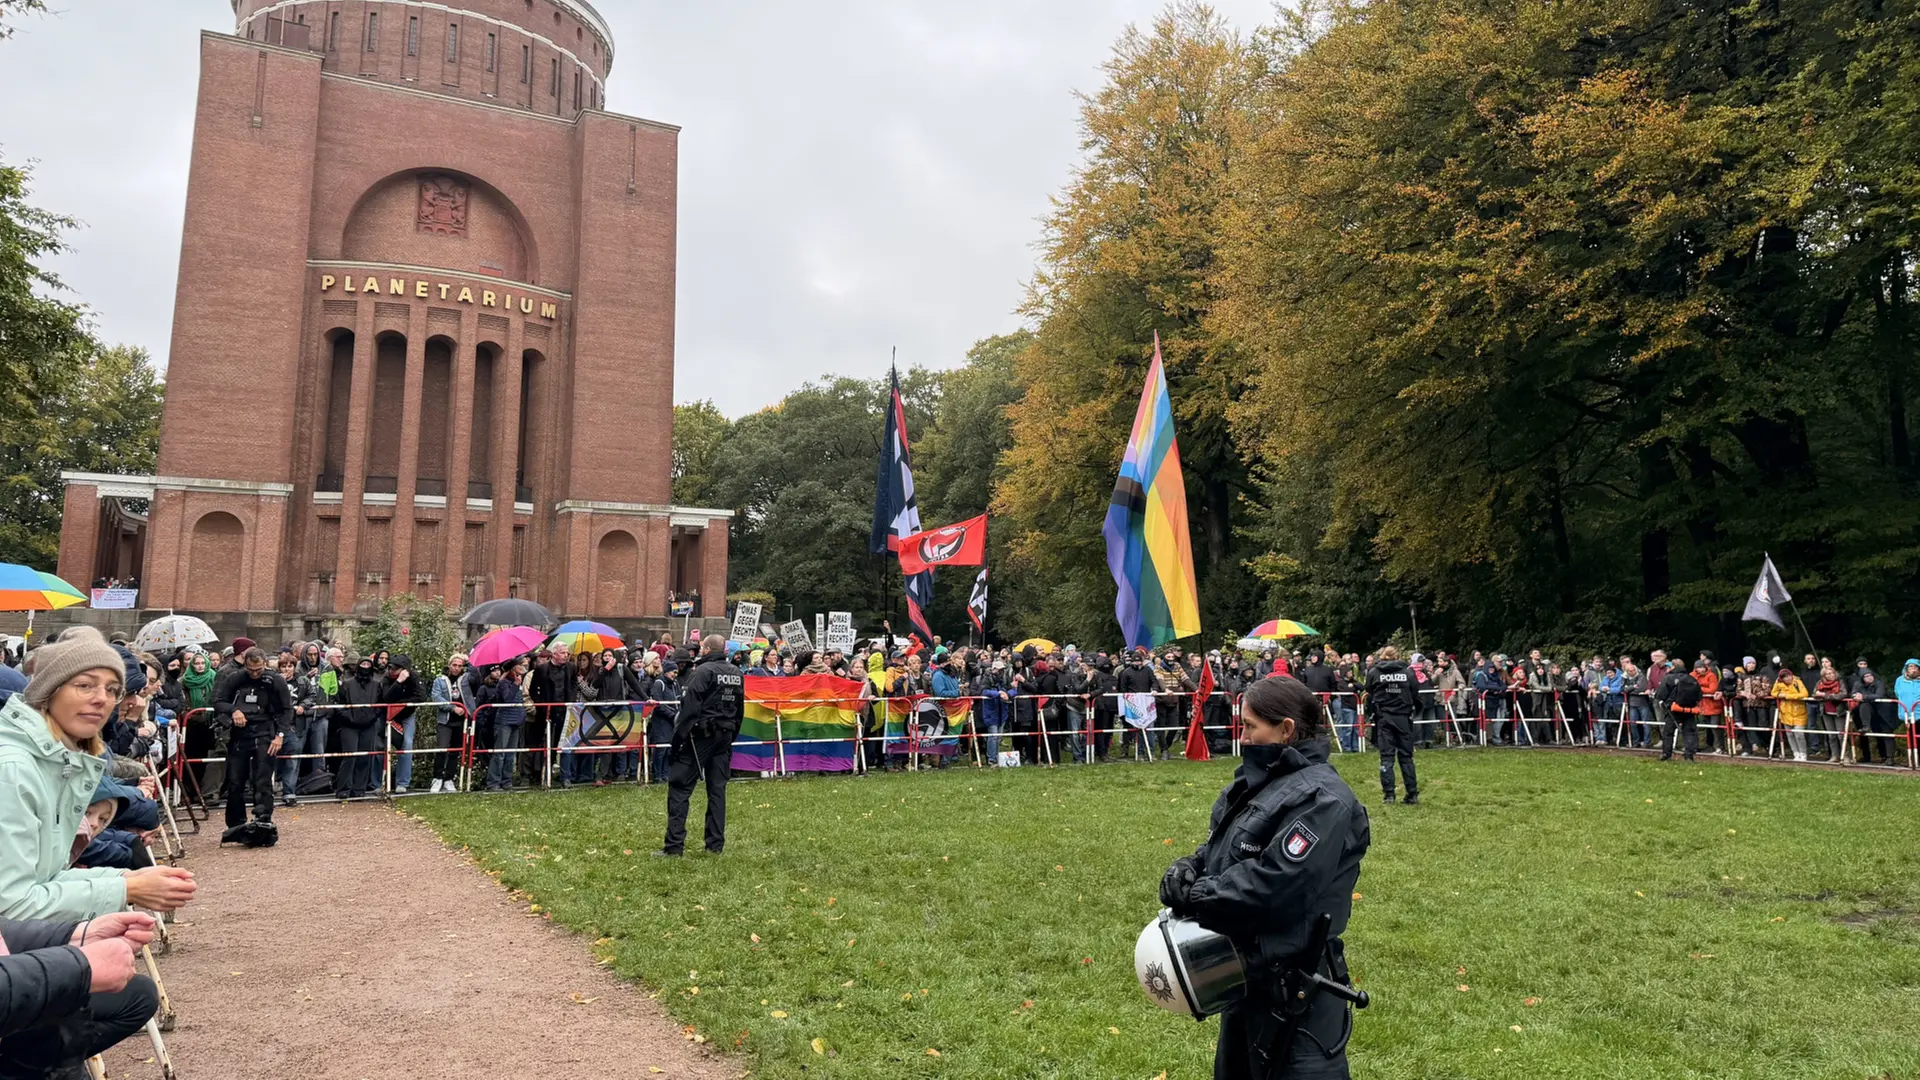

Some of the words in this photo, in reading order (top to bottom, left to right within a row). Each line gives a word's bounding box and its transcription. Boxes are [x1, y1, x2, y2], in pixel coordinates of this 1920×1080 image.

[321, 274, 556, 319] PLANETARIUM
[741, 604, 757, 616] OMAS
[737, 615, 756, 627] GEGEN
[832, 614, 847, 624] OMAS
[733, 626, 755, 637] RECHTS
[784, 622, 799, 634] OMAS
[830, 624, 848, 633] GEGEN
[787, 633, 806, 645] GEGEN
[829, 634, 849, 643] RECHTS
[717, 674, 741, 686] POLIZEI
[1380, 673, 1407, 682] POLIZEI
[1295, 823, 1316, 843] POLIZEI
